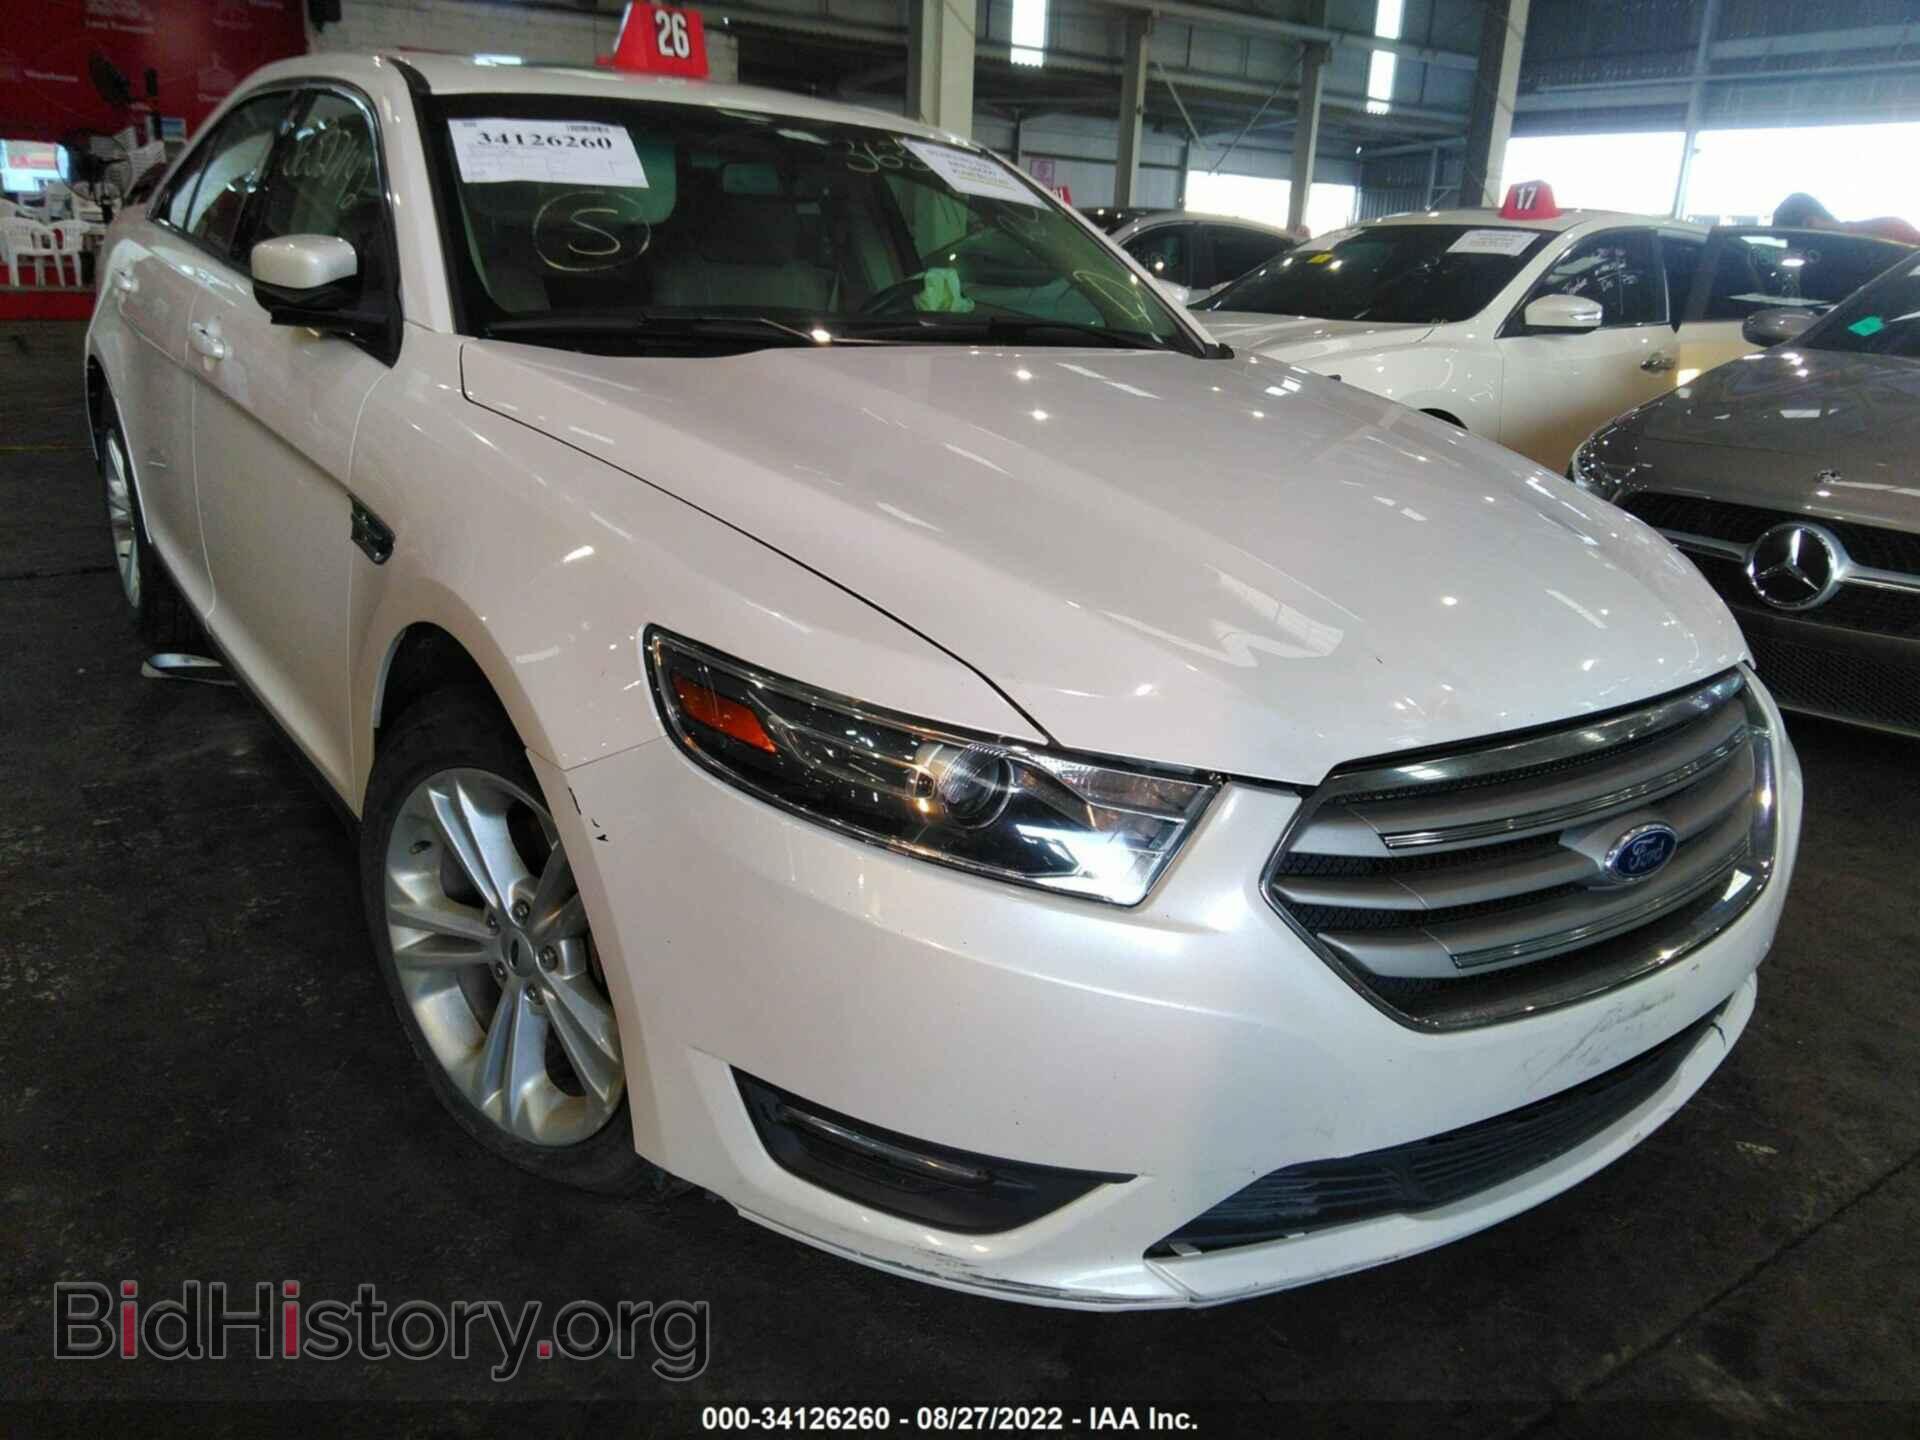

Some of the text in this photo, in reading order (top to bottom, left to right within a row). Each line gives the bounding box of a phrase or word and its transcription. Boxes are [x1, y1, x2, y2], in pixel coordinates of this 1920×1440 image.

[655, 9, 690, 59] 26
[477, 131, 613, 150] 34126260
[1516, 186, 1538, 211] 17
[568, 206, 622, 256] S
[1628, 835, 1665, 871] Ford
